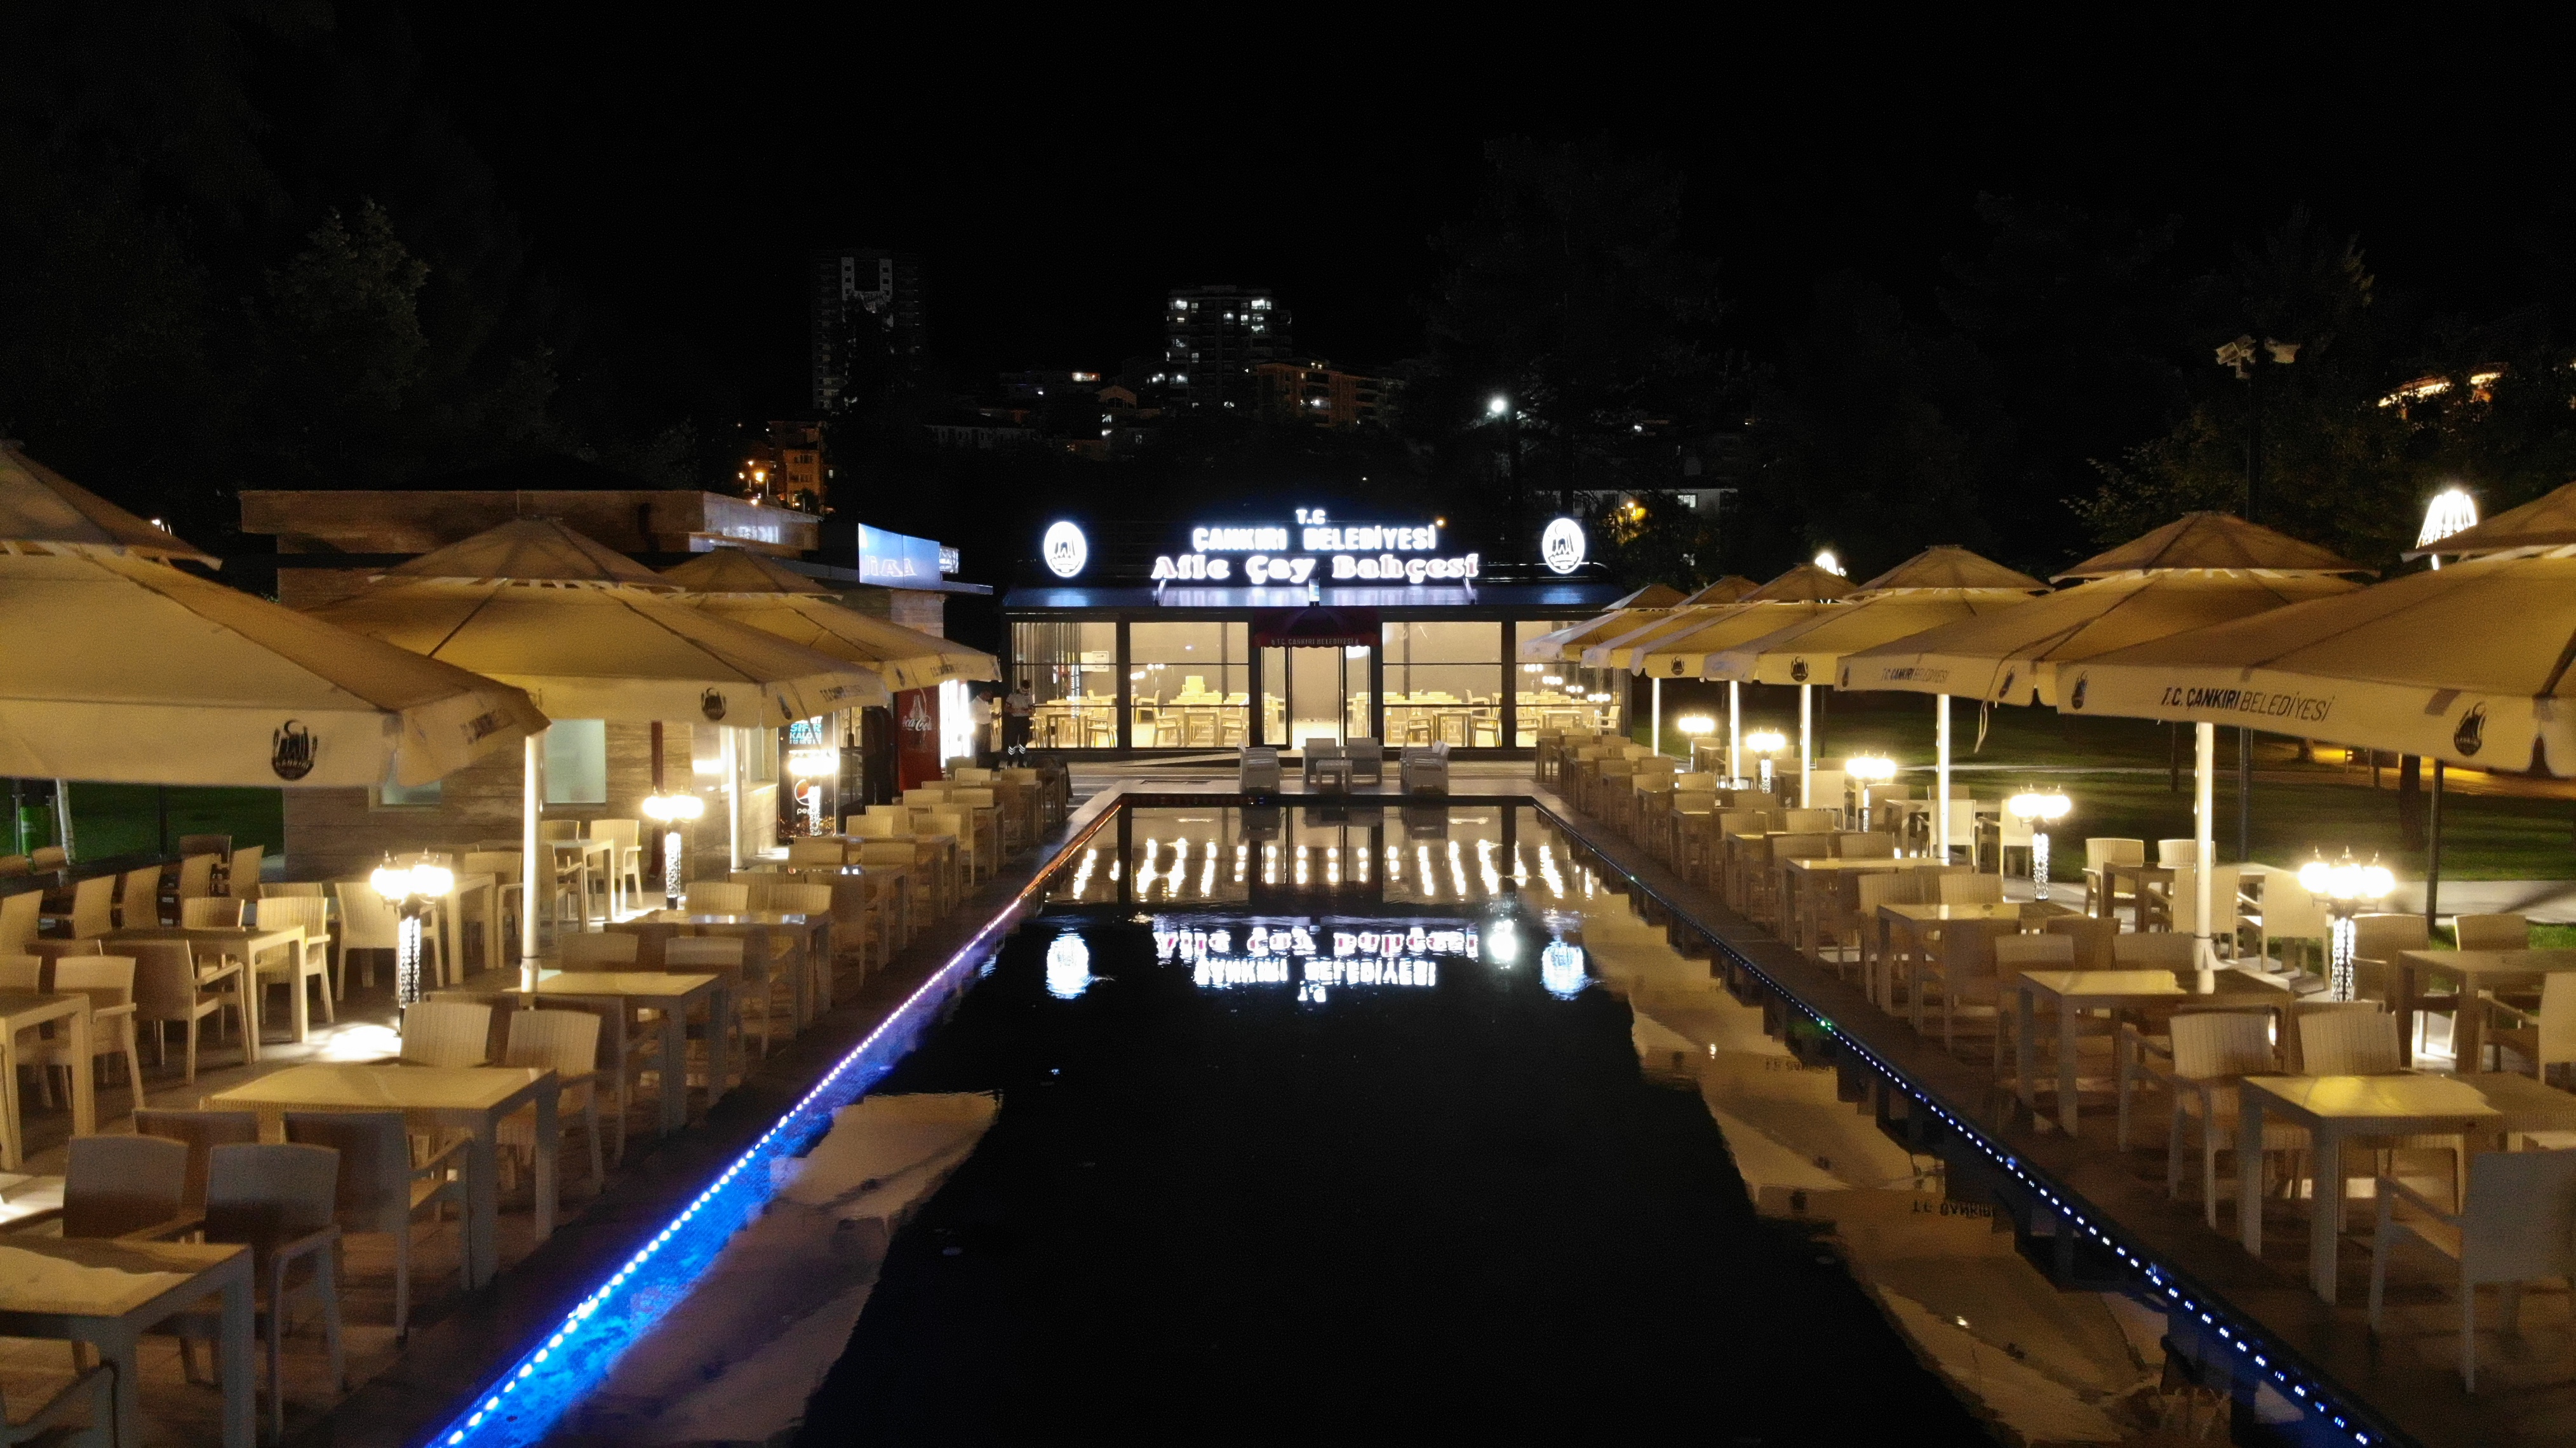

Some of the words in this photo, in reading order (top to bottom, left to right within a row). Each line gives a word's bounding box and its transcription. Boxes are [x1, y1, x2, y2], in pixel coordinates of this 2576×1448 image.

[1296, 509, 1325, 525] T.C
[1193, 528, 1287, 552] ÇANKIRI
[1304, 525, 1435, 550] BELEDİYESİ
[1151, 554, 1230, 579] Aile
[1245, 555, 1316, 584] Çay
[1332, 553, 1479, 584] Bahçesi
[2161, 687, 2182, 706] T.C.
[2185, 688, 2242, 711] ÇANKIRI
[2239, 690, 2337, 723] BELEDİYESİ
